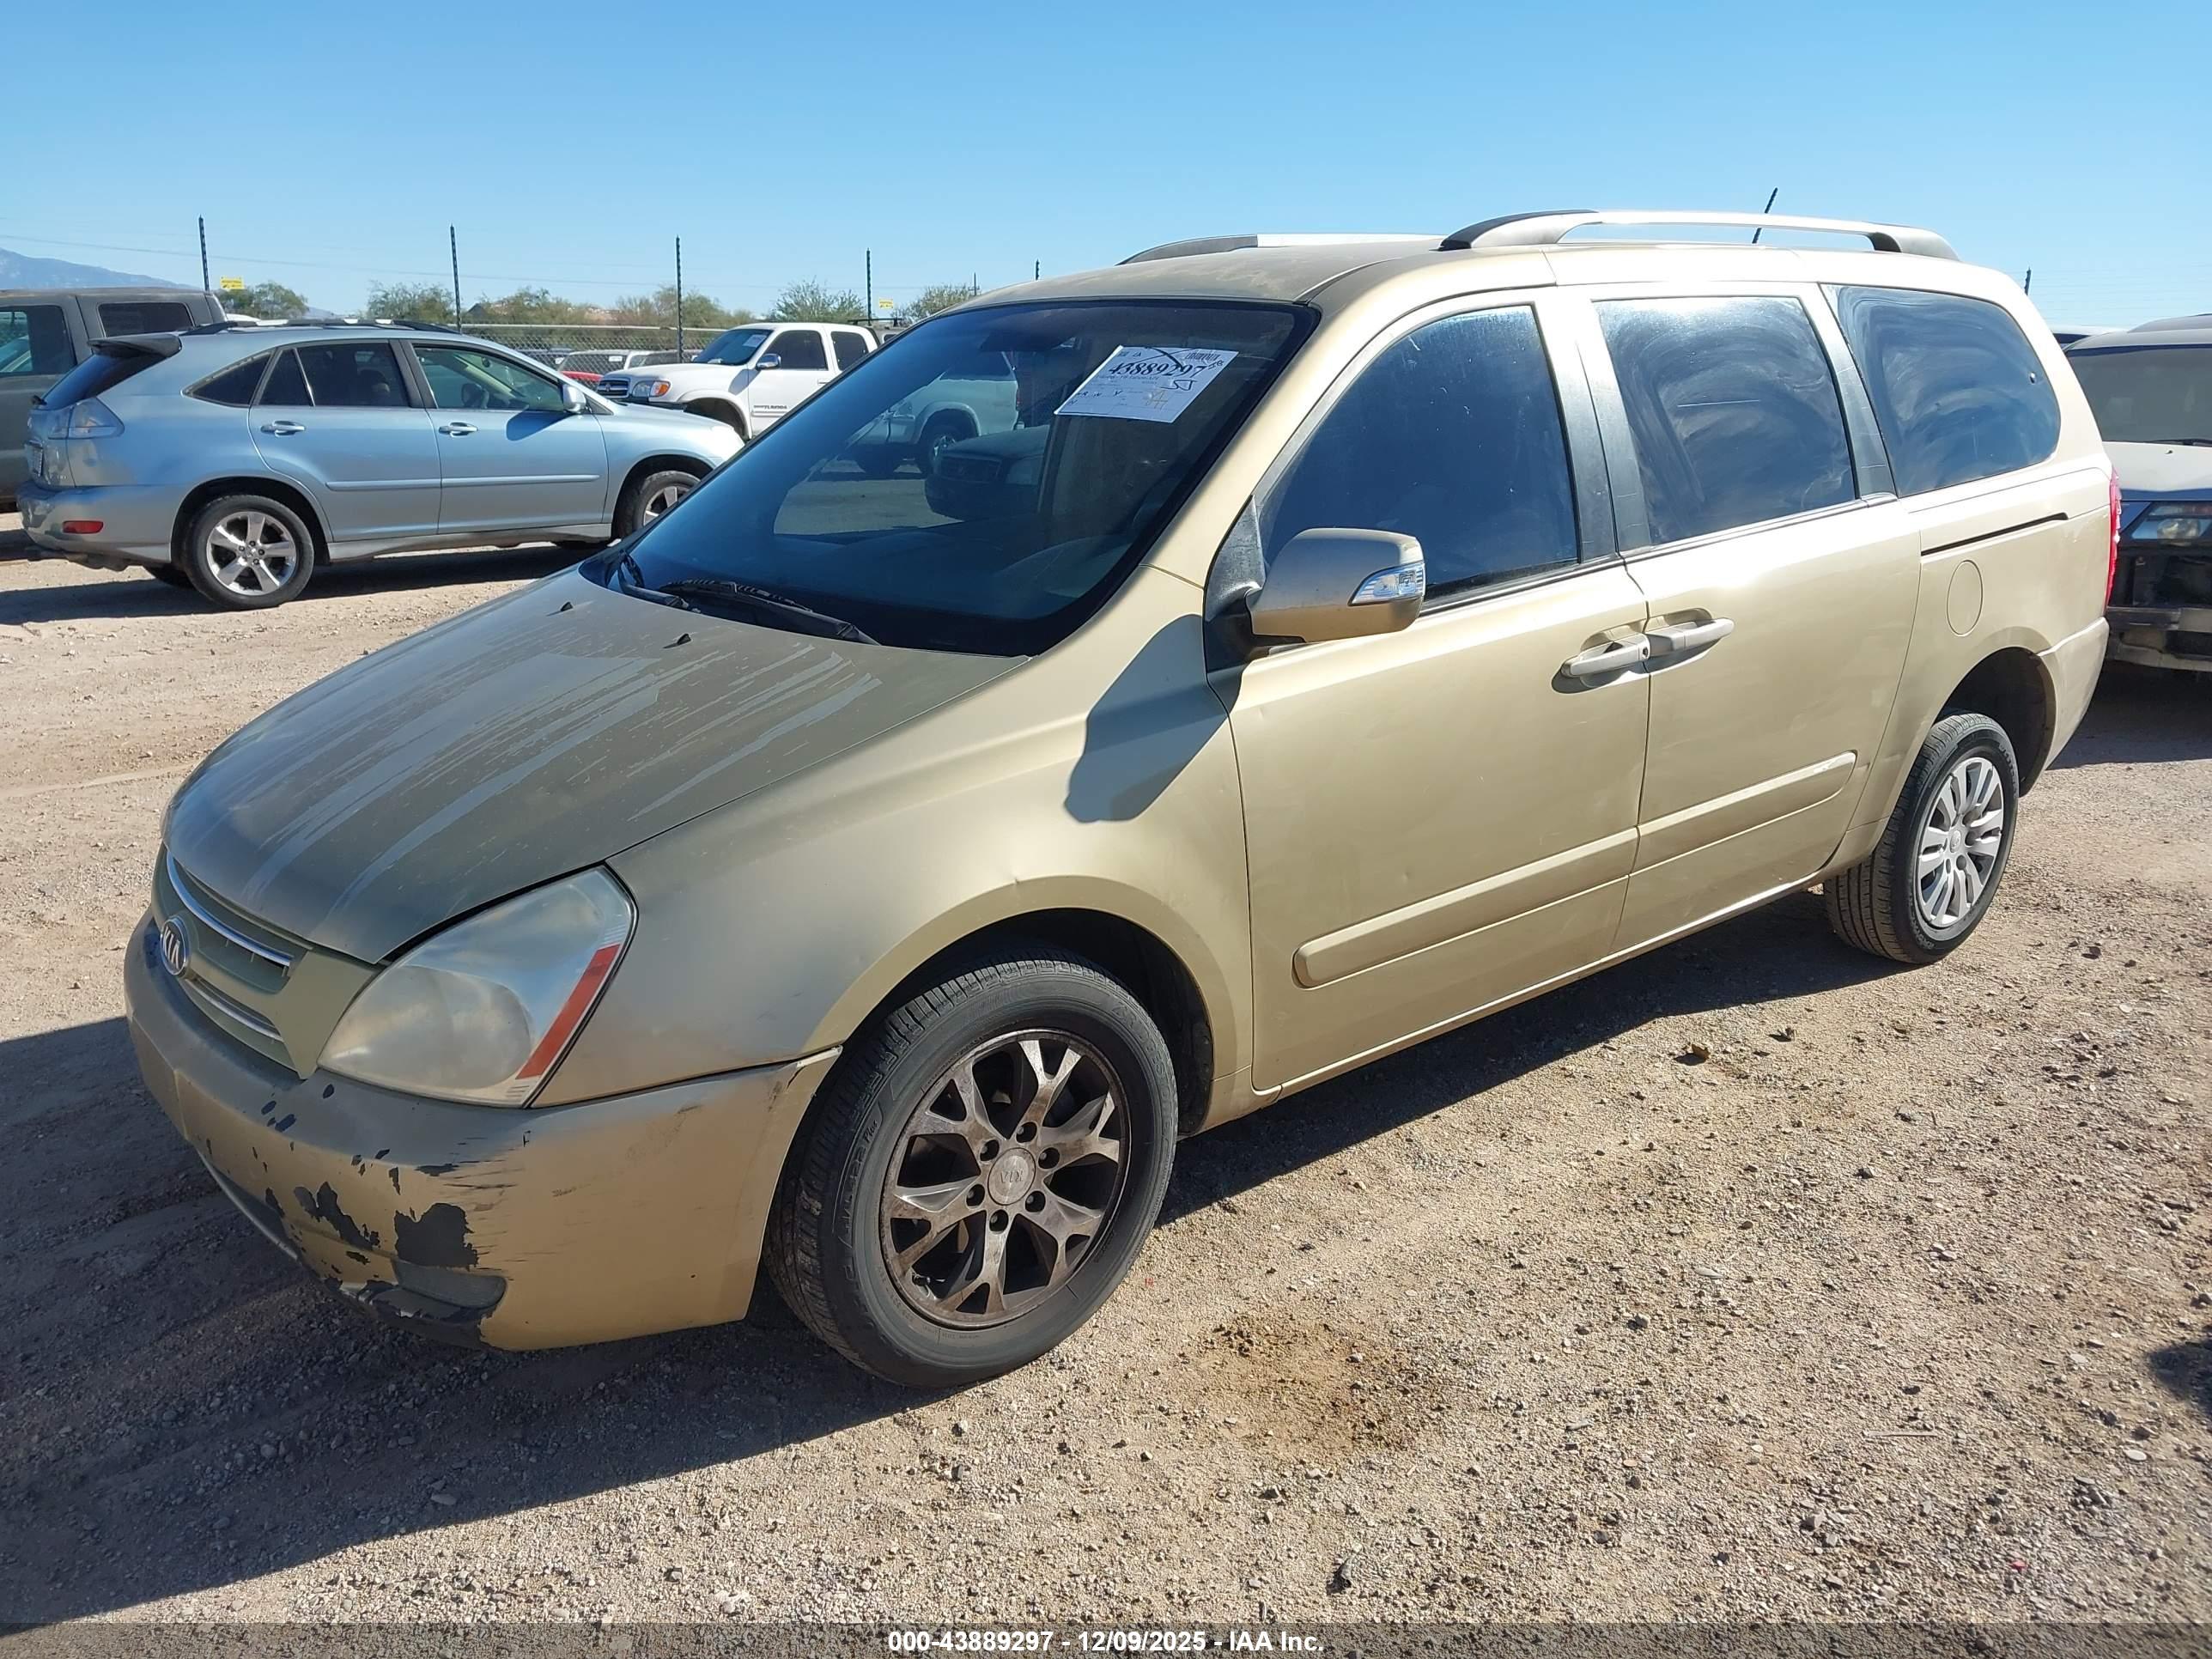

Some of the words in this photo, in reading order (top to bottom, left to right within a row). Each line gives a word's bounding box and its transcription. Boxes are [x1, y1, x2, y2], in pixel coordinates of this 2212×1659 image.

[1109, 362, 1207, 378] 43889297
[163, 925, 180, 969] KIA
[1000, 1169, 1024, 1183] KIA
